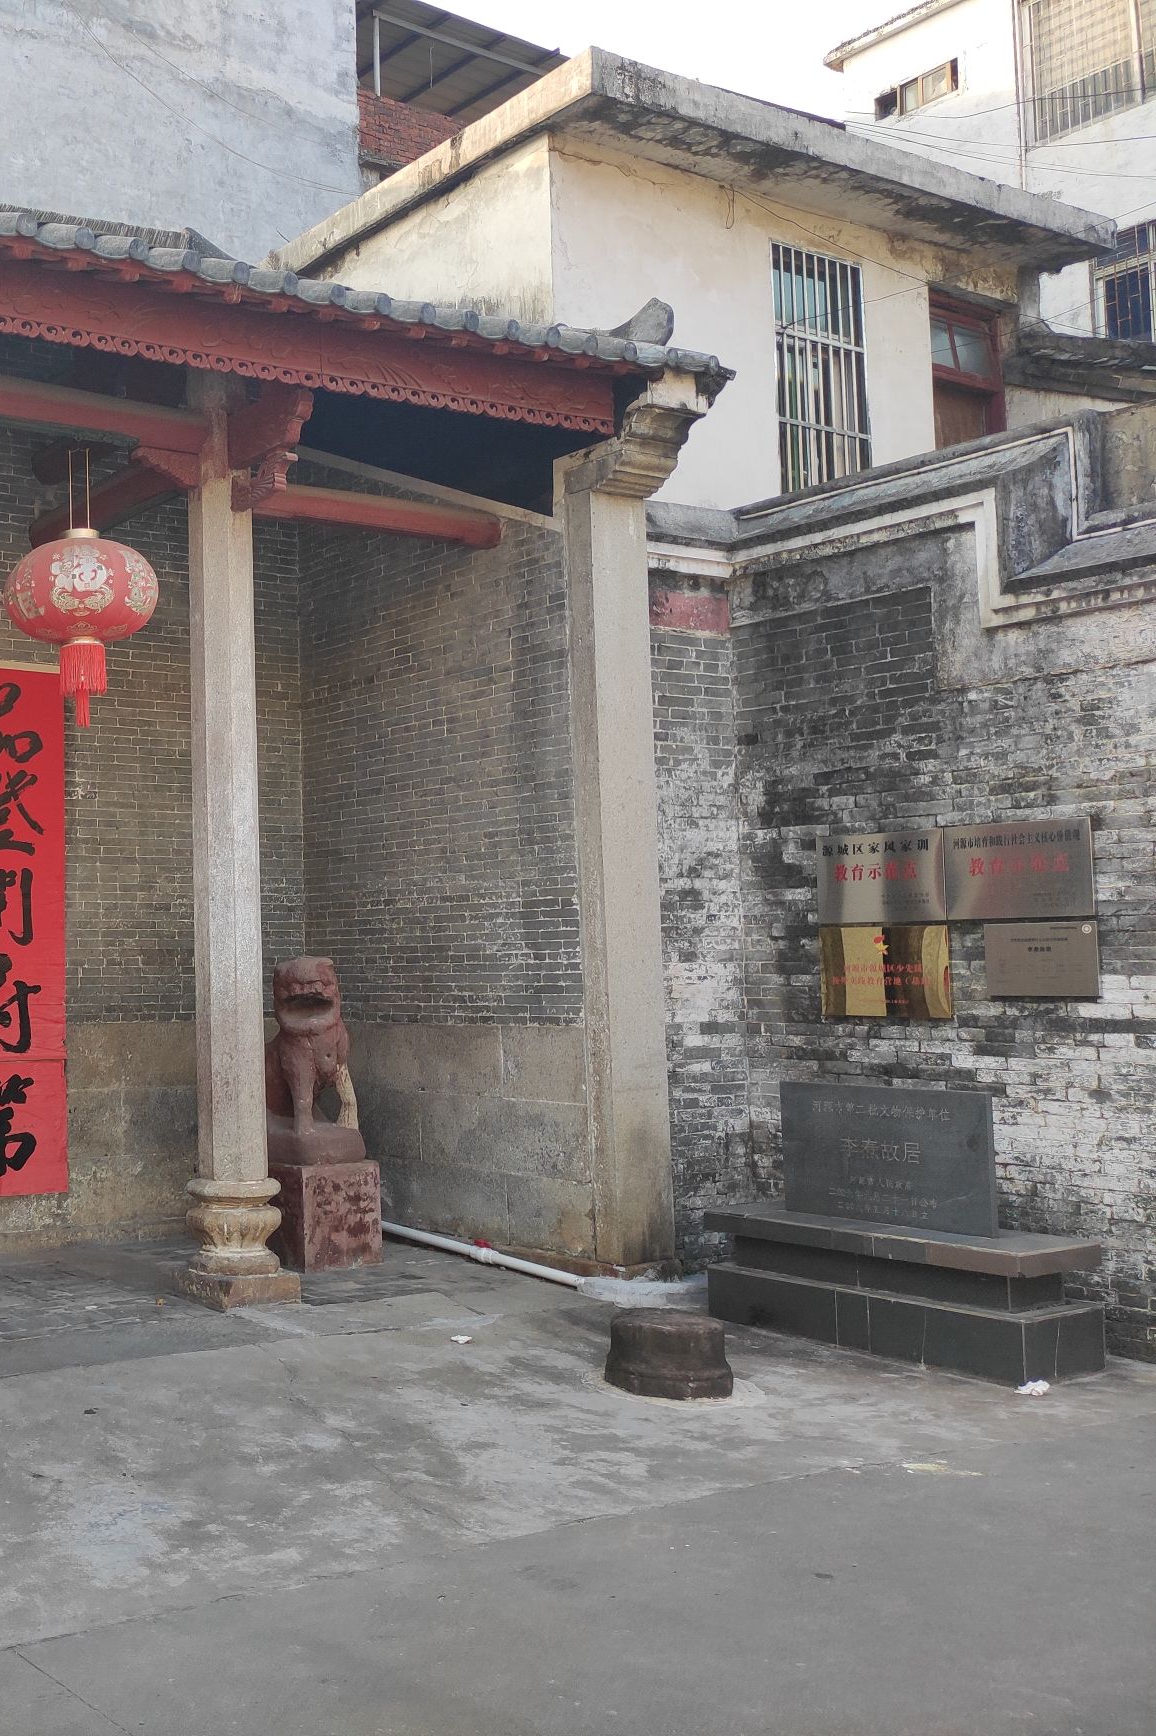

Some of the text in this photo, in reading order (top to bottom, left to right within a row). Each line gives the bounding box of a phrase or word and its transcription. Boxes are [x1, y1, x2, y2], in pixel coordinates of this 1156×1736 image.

[822, 838, 929, 857] 源城区家风家训
[952, 828, 1081, 850] 河源市培育和践行社会主义核心价值观
[834, 860, 918, 882] 教育示范点
